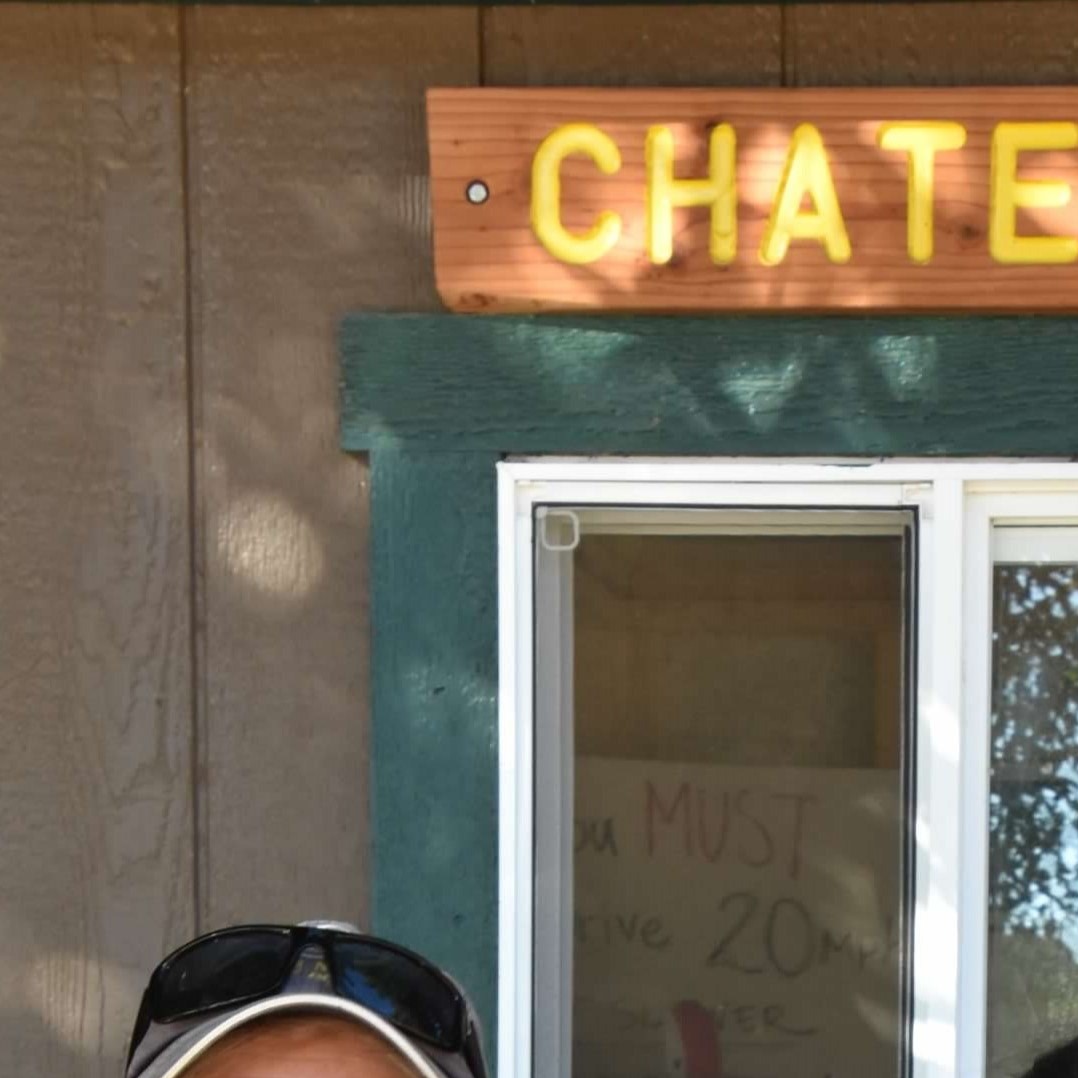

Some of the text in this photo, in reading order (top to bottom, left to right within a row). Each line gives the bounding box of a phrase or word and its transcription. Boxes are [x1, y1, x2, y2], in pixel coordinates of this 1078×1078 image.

[573, 778, 824, 881] ou MUST
[573, 904, 674, 950] rive
[705, 891, 817, 978] 20
